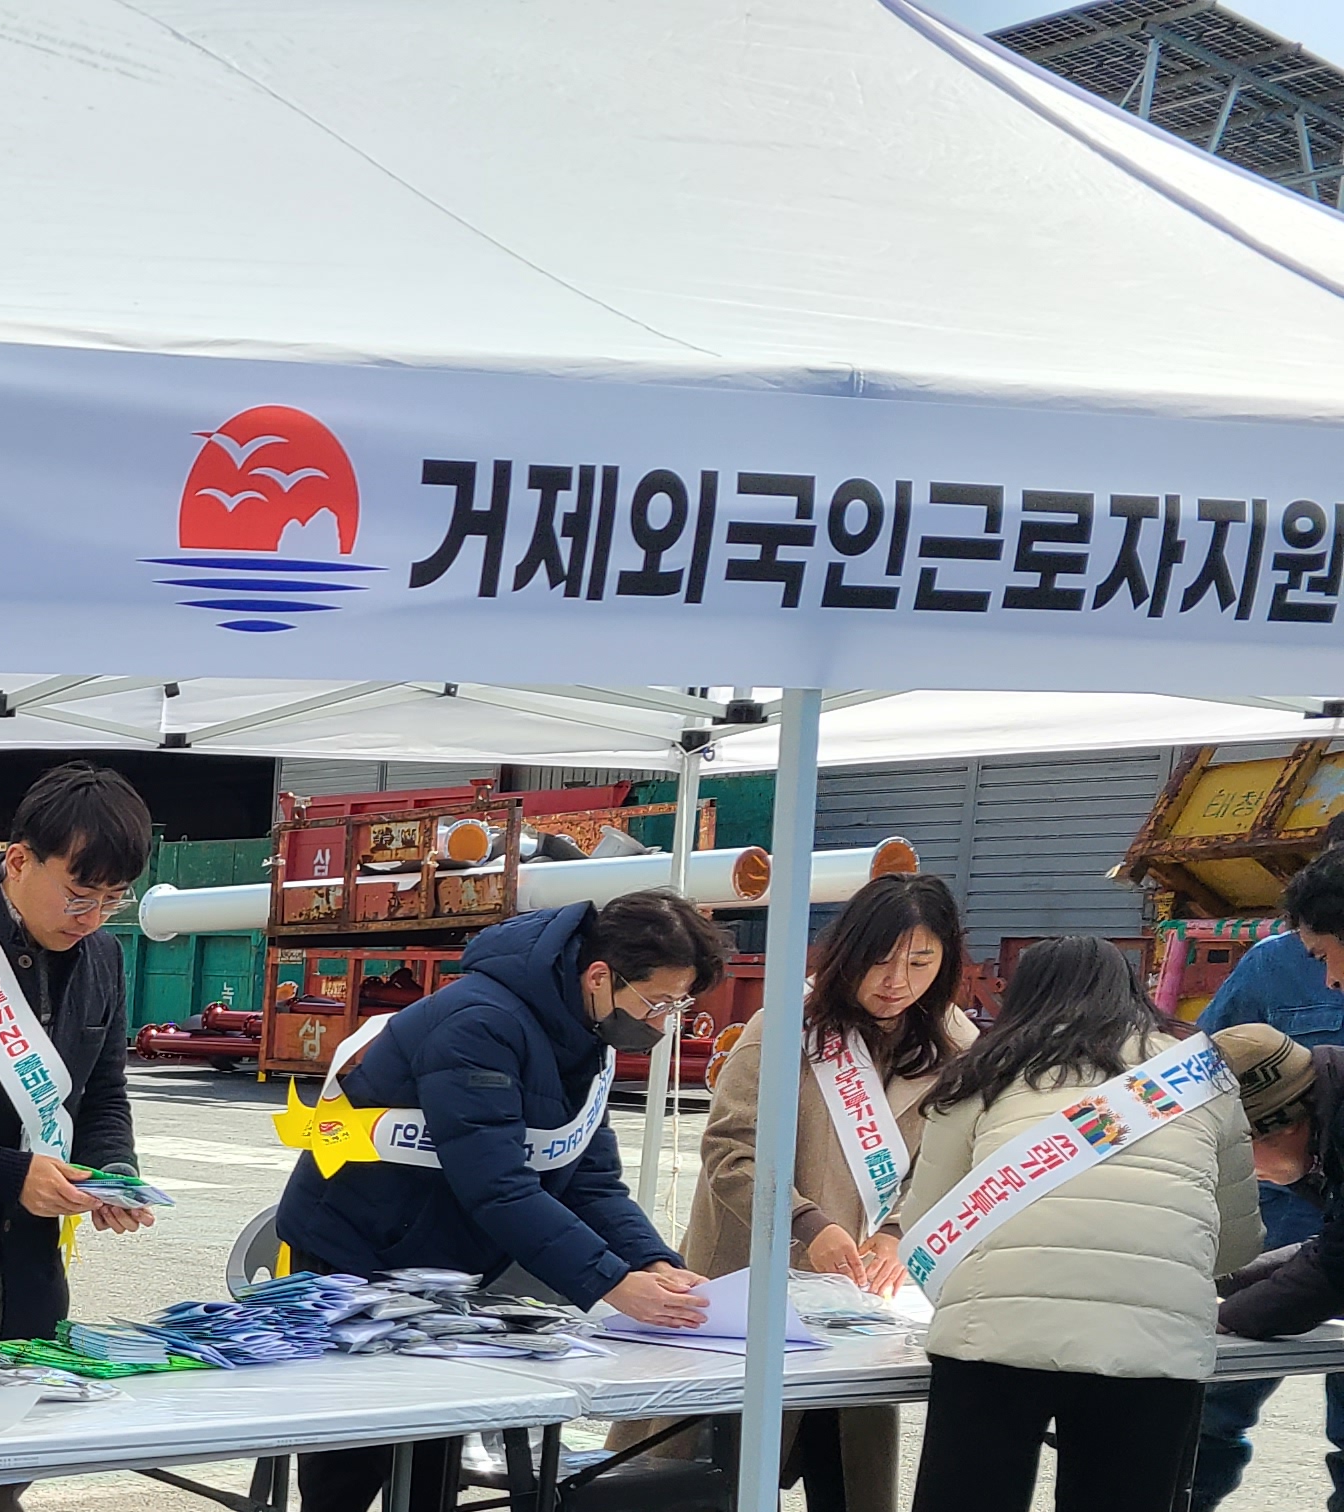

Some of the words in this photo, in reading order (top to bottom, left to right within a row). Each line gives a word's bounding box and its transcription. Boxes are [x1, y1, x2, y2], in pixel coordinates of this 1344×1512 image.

[833, 1069, 877, 1122] 무단투기
[854, 1121, 884, 1152] NO
[1026, 1131, 1081, 1182] 쓰레기
[956, 1163, 1027, 1232] 무단투기
[924, 1218, 963, 1258] NO
